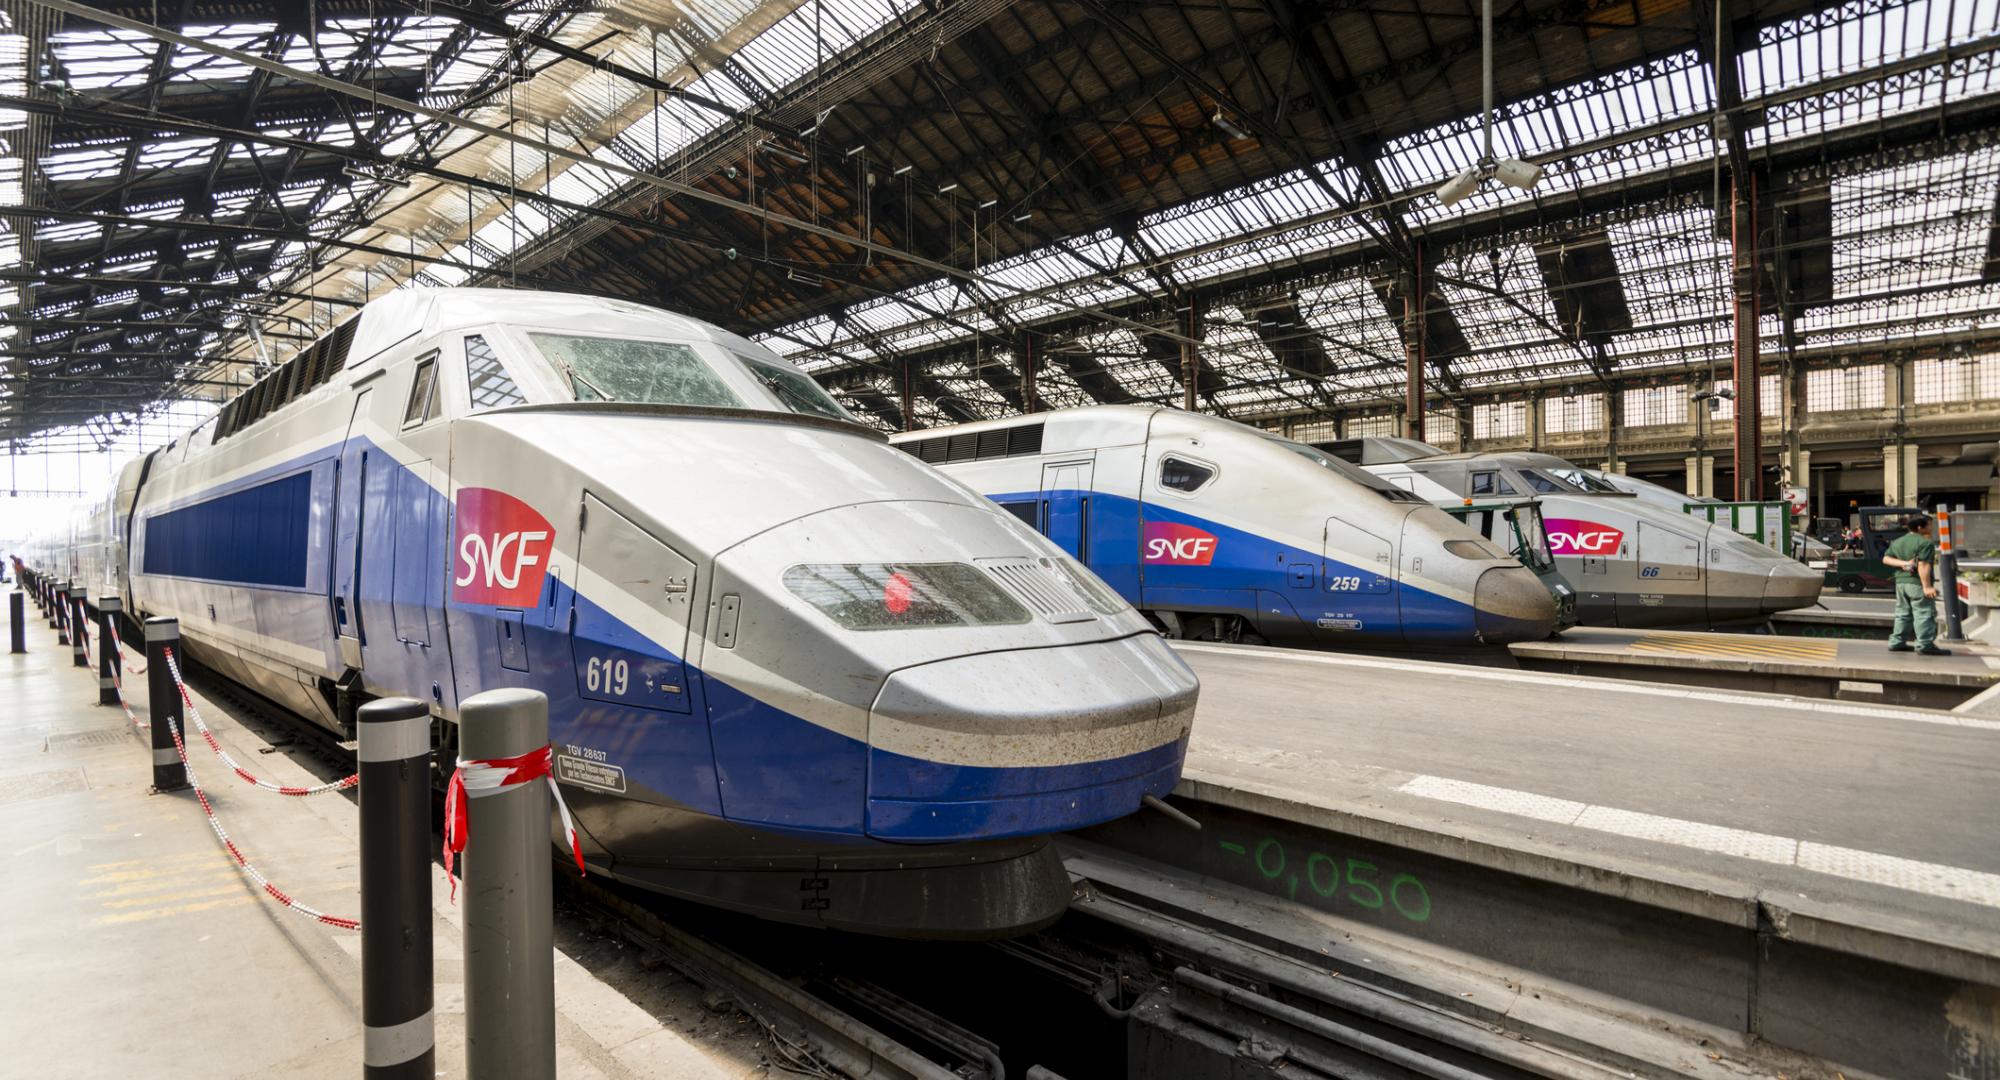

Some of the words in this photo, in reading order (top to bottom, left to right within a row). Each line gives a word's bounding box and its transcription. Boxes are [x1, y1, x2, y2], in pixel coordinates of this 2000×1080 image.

[1146, 538, 1214, 559] SNCF
[1544, 532, 1619, 550] SNCF
[456, 531, 547, 589] SNCF
[1641, 567, 1660, 577] 66
[1330, 576, 1360, 591] 259
[587, 657, 629, 696] 619
[566, 744, 582, 757] TGV
[583, 747, 607, 762] 28637
